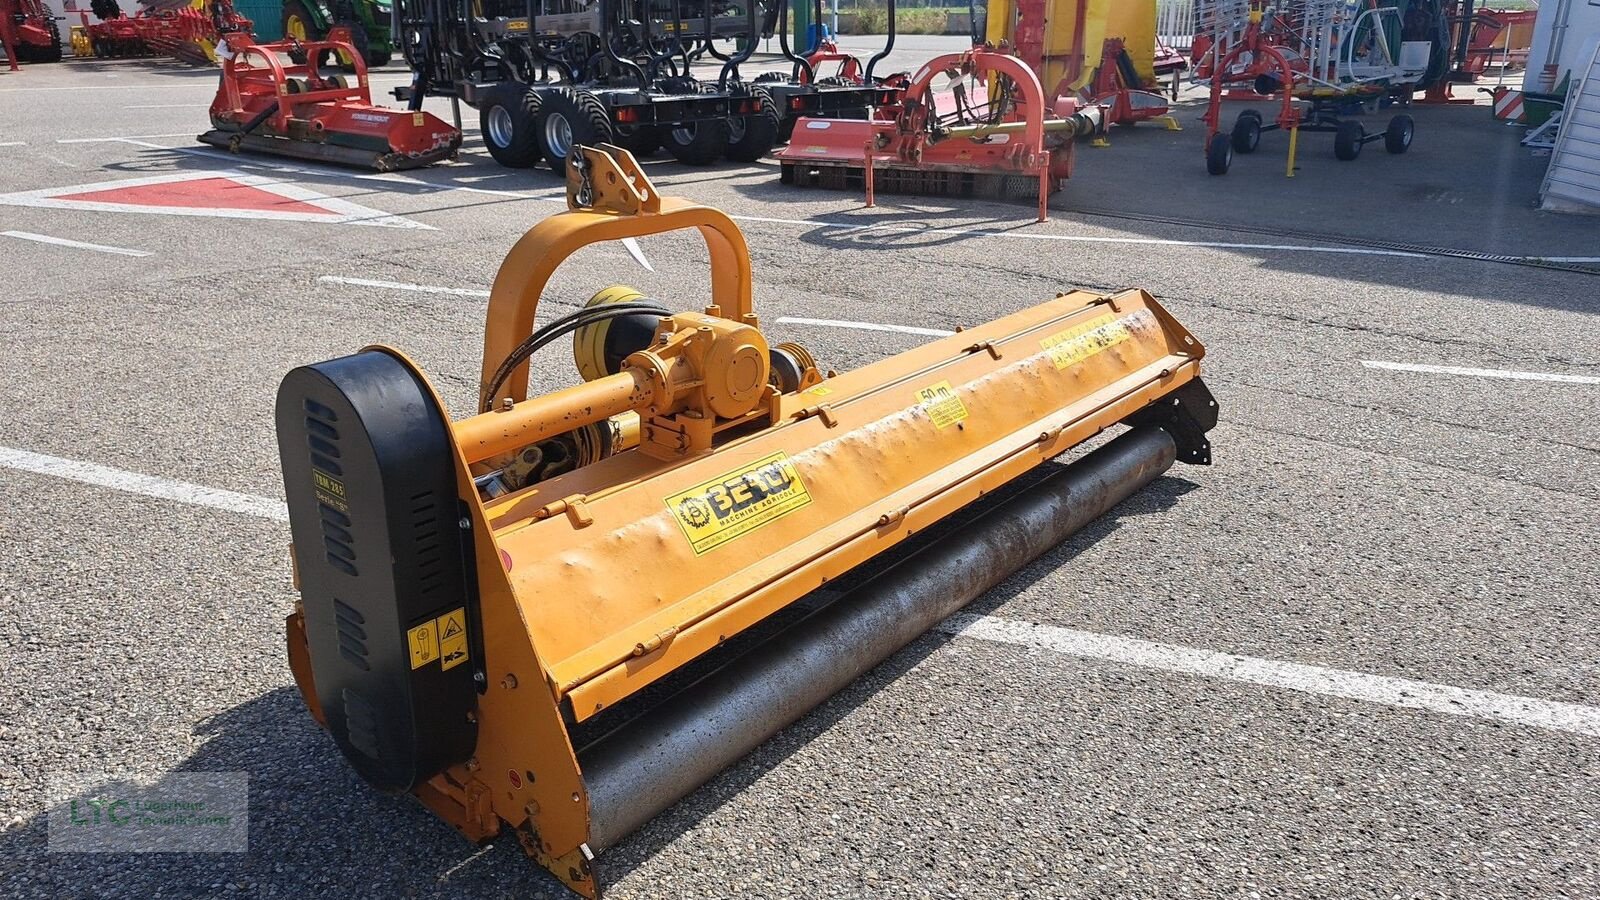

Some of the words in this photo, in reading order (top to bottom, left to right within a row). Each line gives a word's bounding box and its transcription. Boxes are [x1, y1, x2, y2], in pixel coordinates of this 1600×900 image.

[315, 473, 330, 489] TBM
[330, 481, 344, 496] 285
[315, 490, 335, 506] Serie
[719, 505, 760, 527] MACCHINE
[761, 487, 796, 508] AGRICOLE
